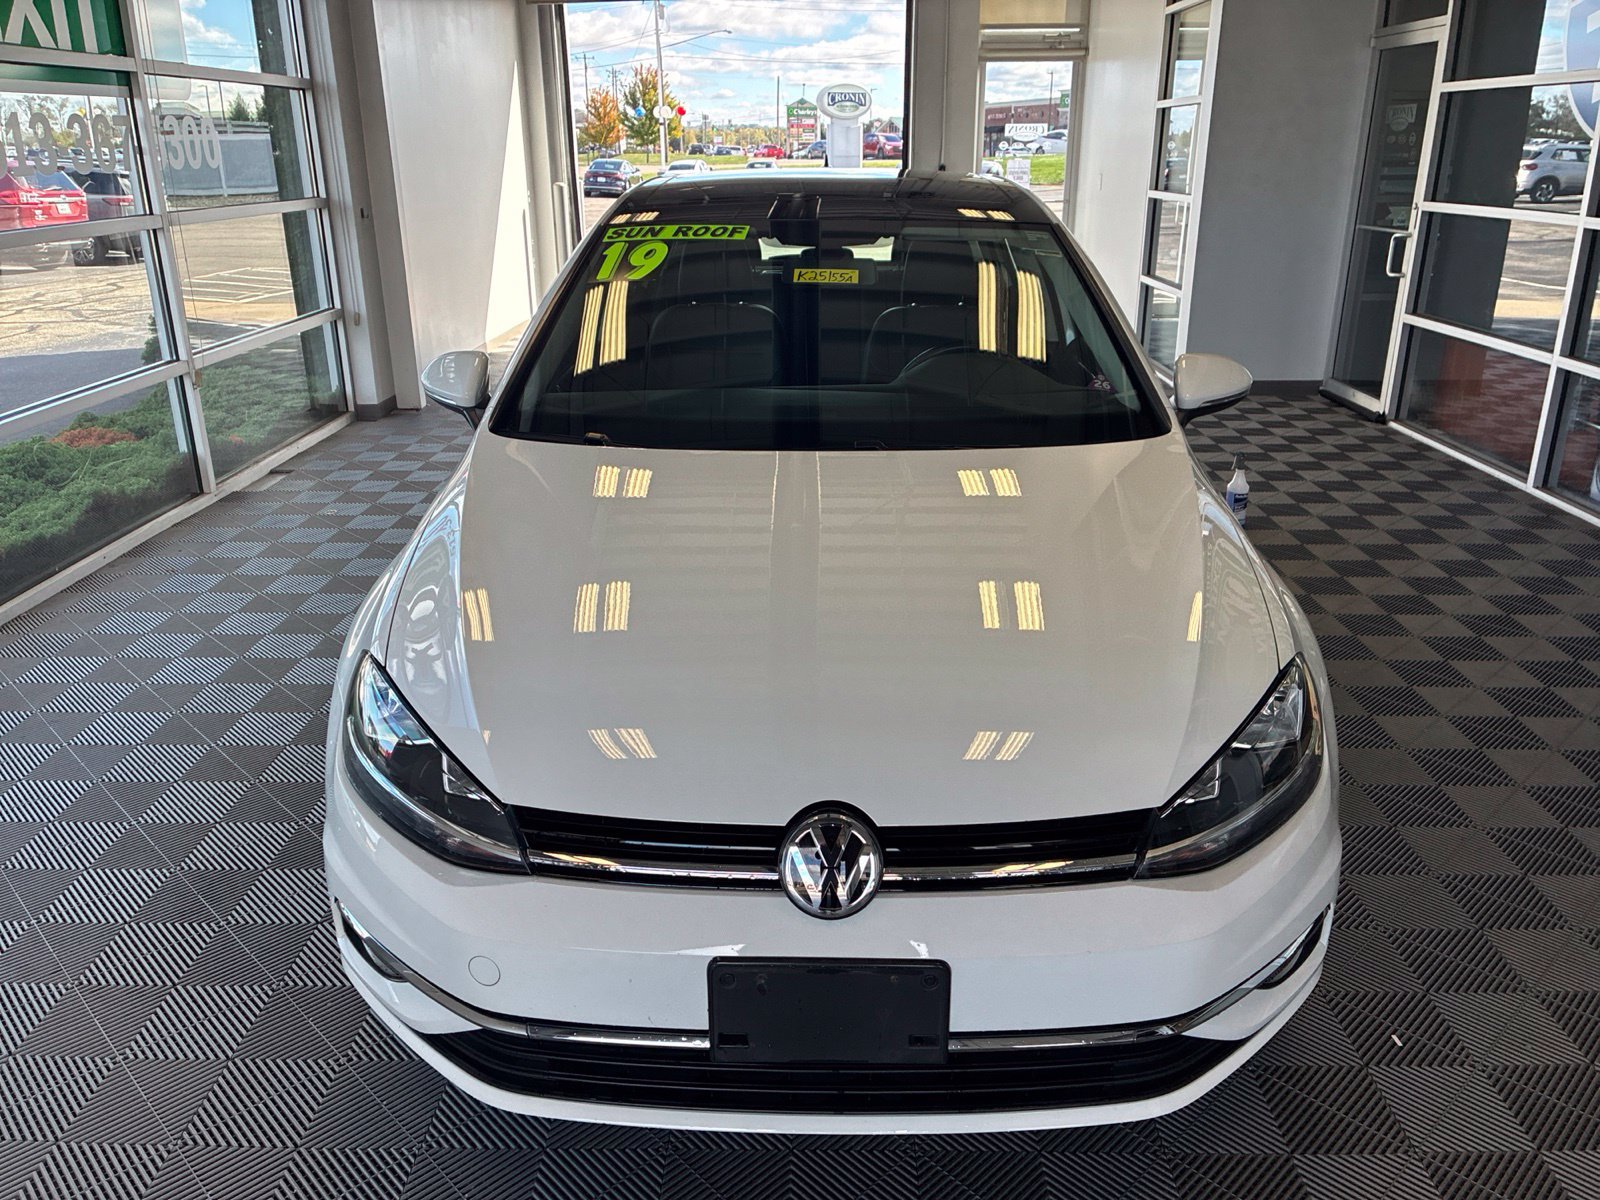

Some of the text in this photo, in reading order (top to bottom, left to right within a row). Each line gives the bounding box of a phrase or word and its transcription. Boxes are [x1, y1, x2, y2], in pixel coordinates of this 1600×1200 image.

[829, 92, 866, 106] CRONIN
[159, 115, 220, 170] 300
[607, 225, 747, 240] SUN ROOF
[596, 240, 668, 281] 19
[1094, 379, 1110, 389] 26
